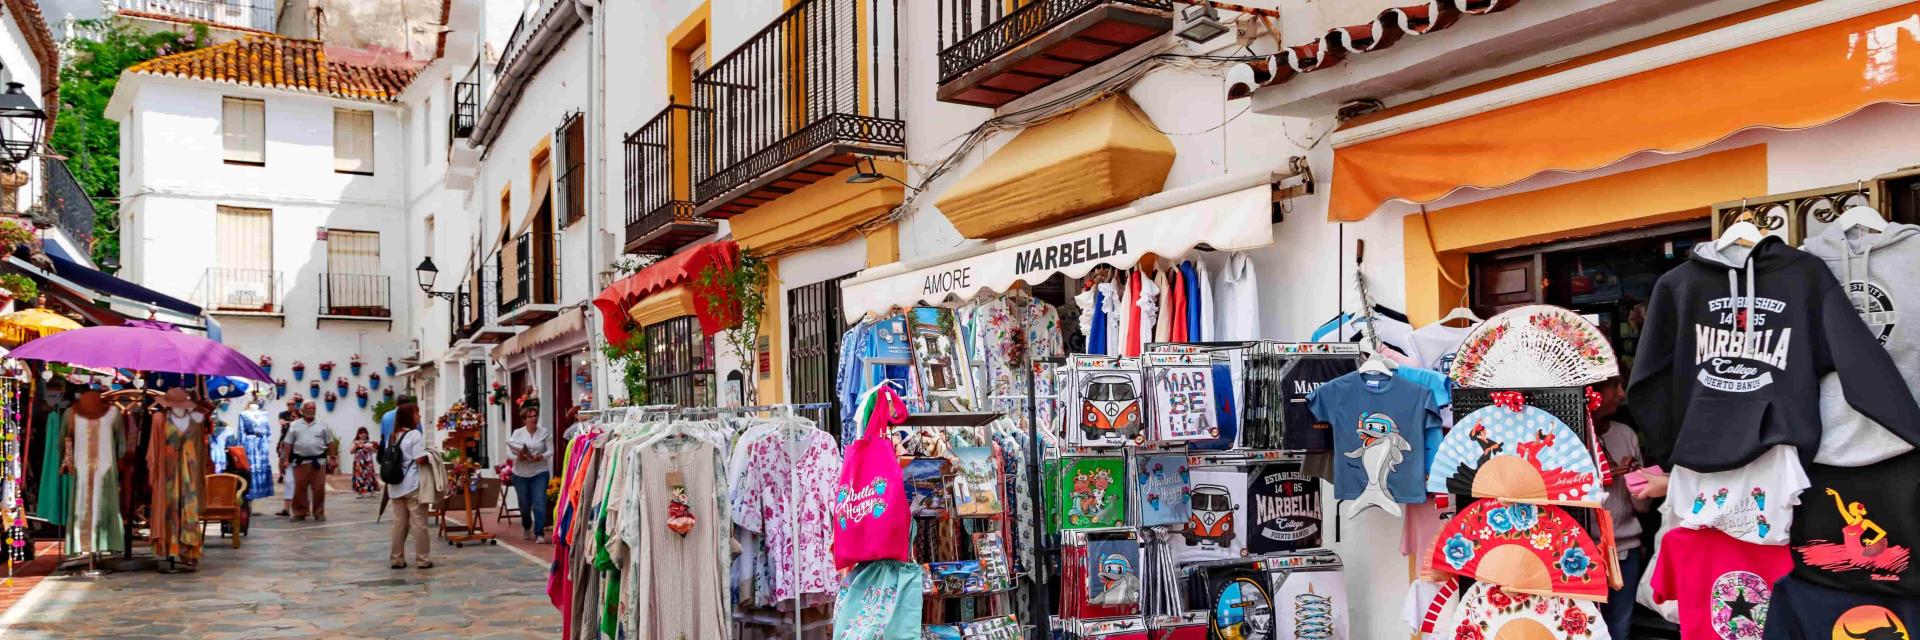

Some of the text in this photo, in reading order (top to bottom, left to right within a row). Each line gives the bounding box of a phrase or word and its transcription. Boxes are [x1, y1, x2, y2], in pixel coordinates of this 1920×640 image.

[923, 229, 1128, 295] AMORE MARBELLA
[1708, 296, 1786, 313] ESTABSHED
[1711, 357, 1758, 379] College
[1255, 490, 1323, 526] MARBELLA
[1275, 517, 1304, 531] College
